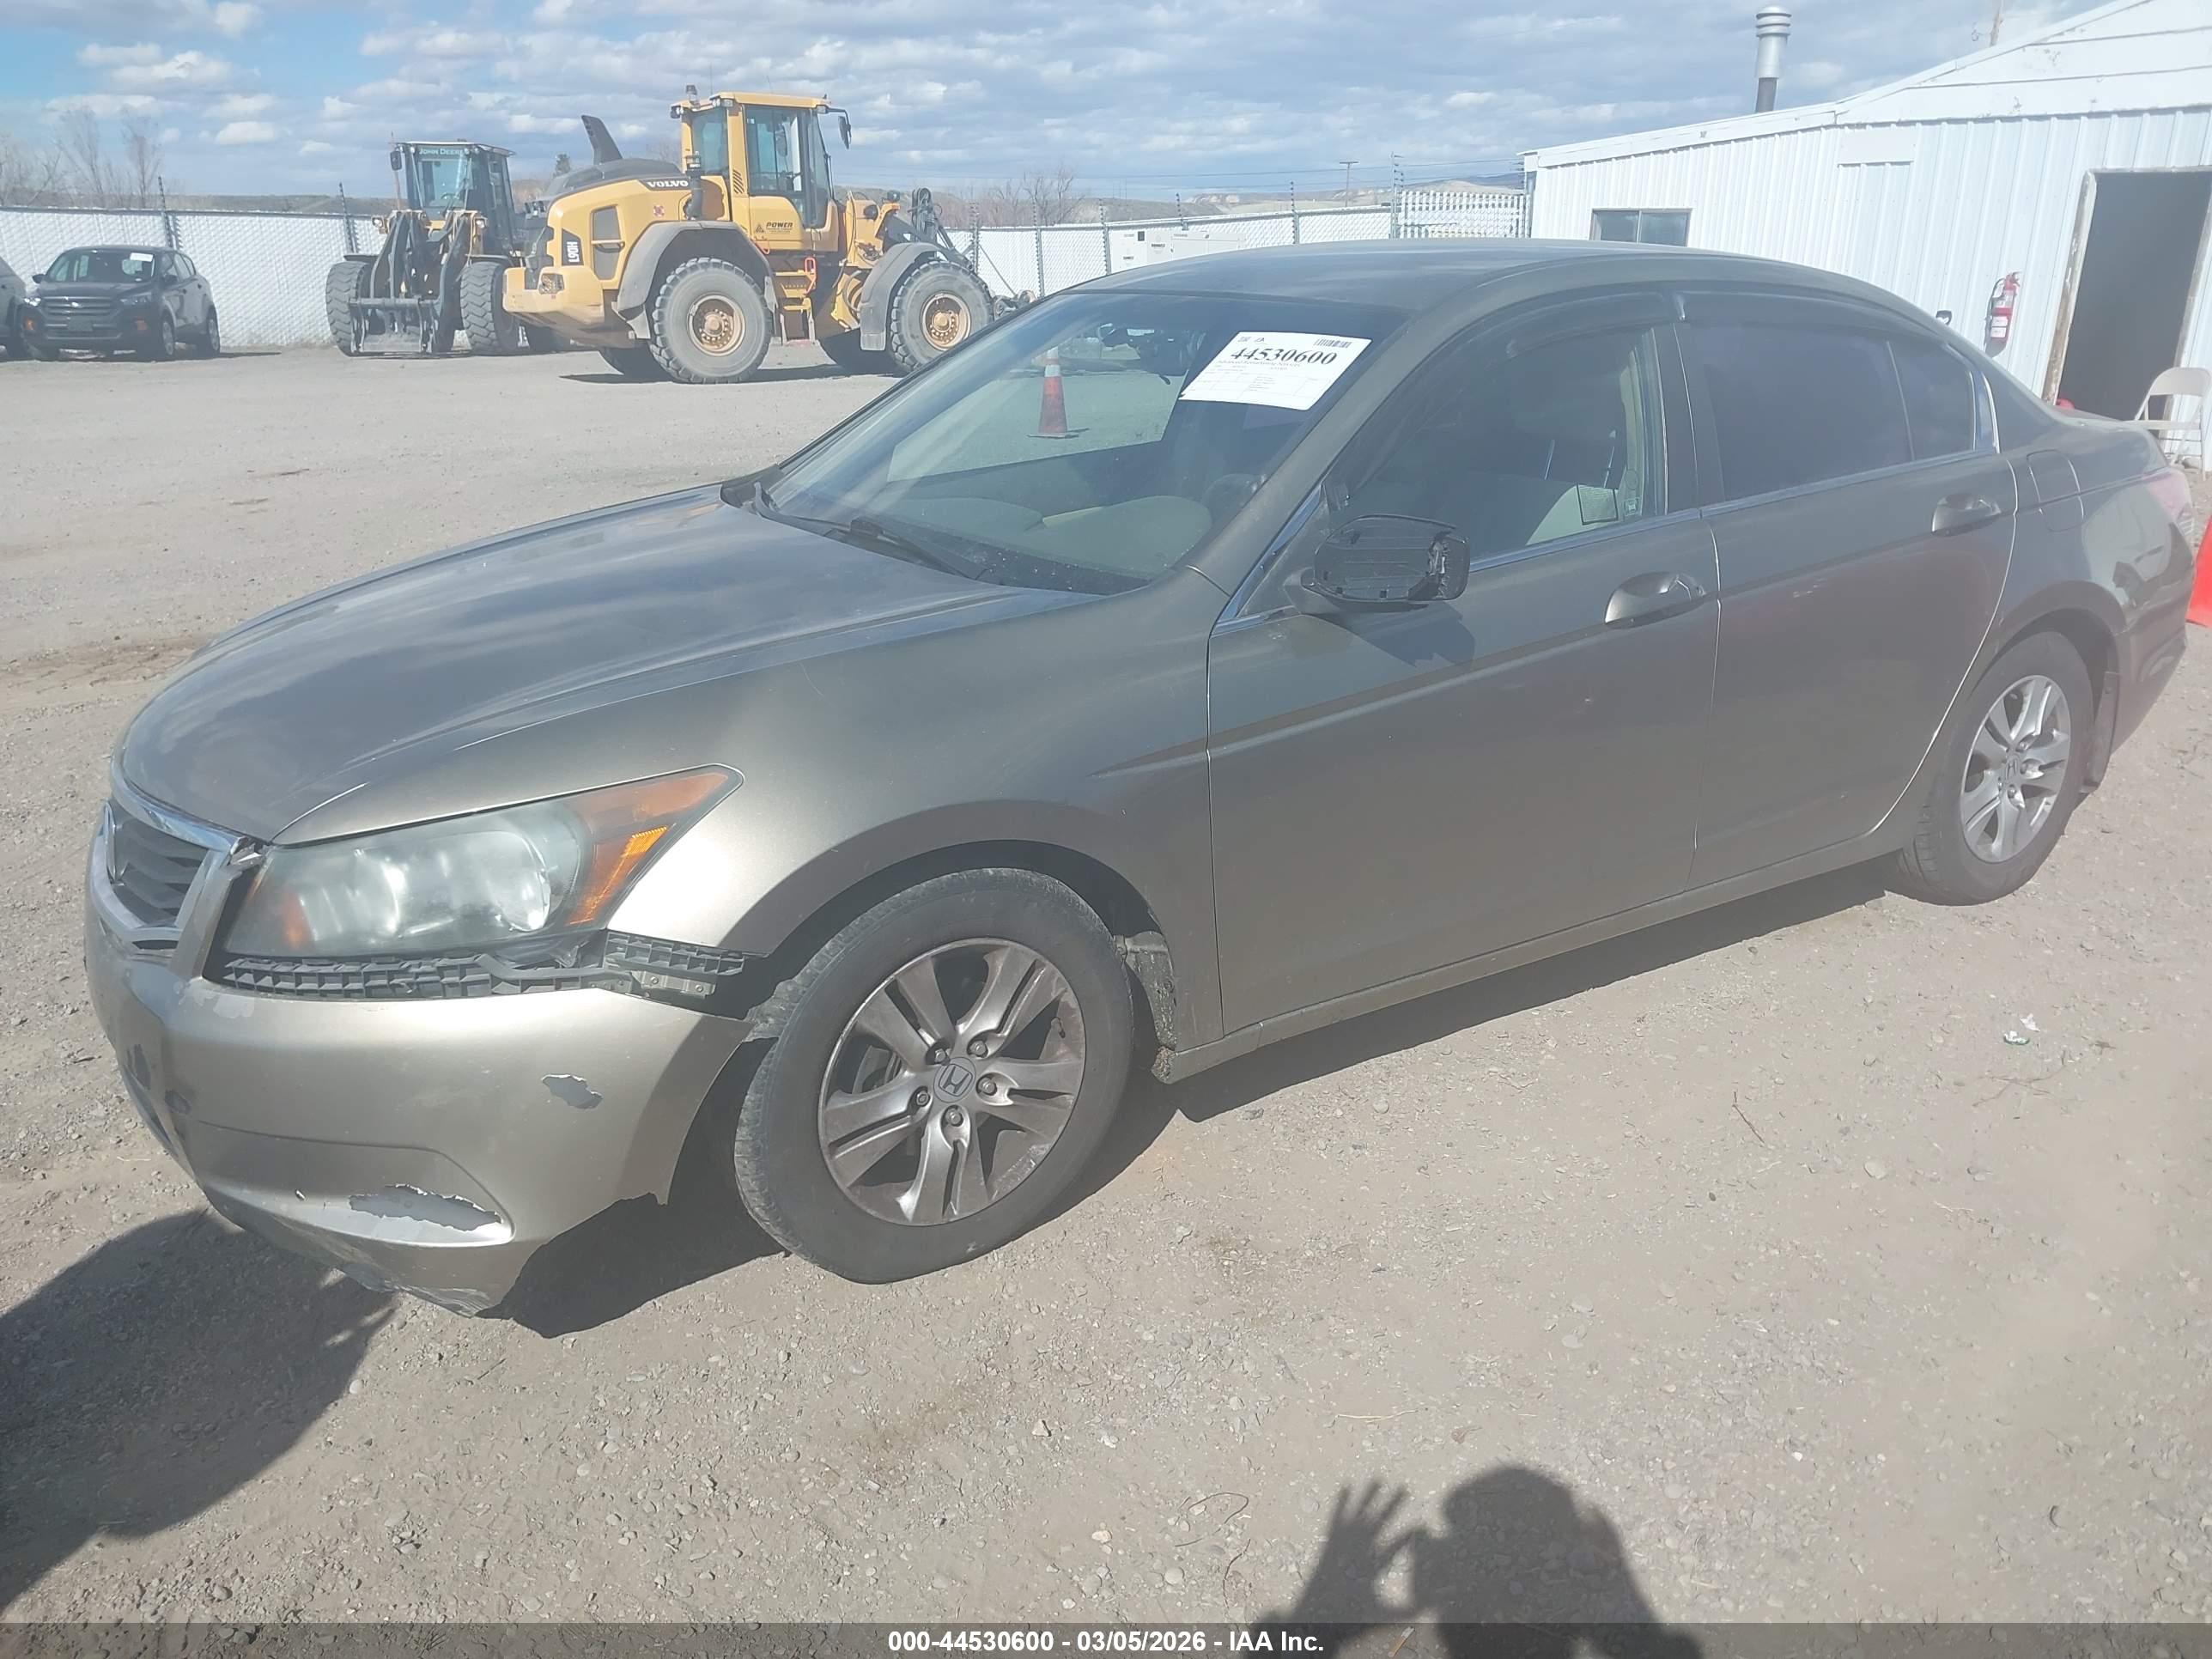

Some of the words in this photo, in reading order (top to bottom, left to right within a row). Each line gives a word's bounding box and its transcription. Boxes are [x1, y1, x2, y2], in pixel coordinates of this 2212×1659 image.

[647, 179, 689, 188] VOLVO
[567, 241, 580, 262] L90H
[1231, 347, 1338, 365] 44530600
